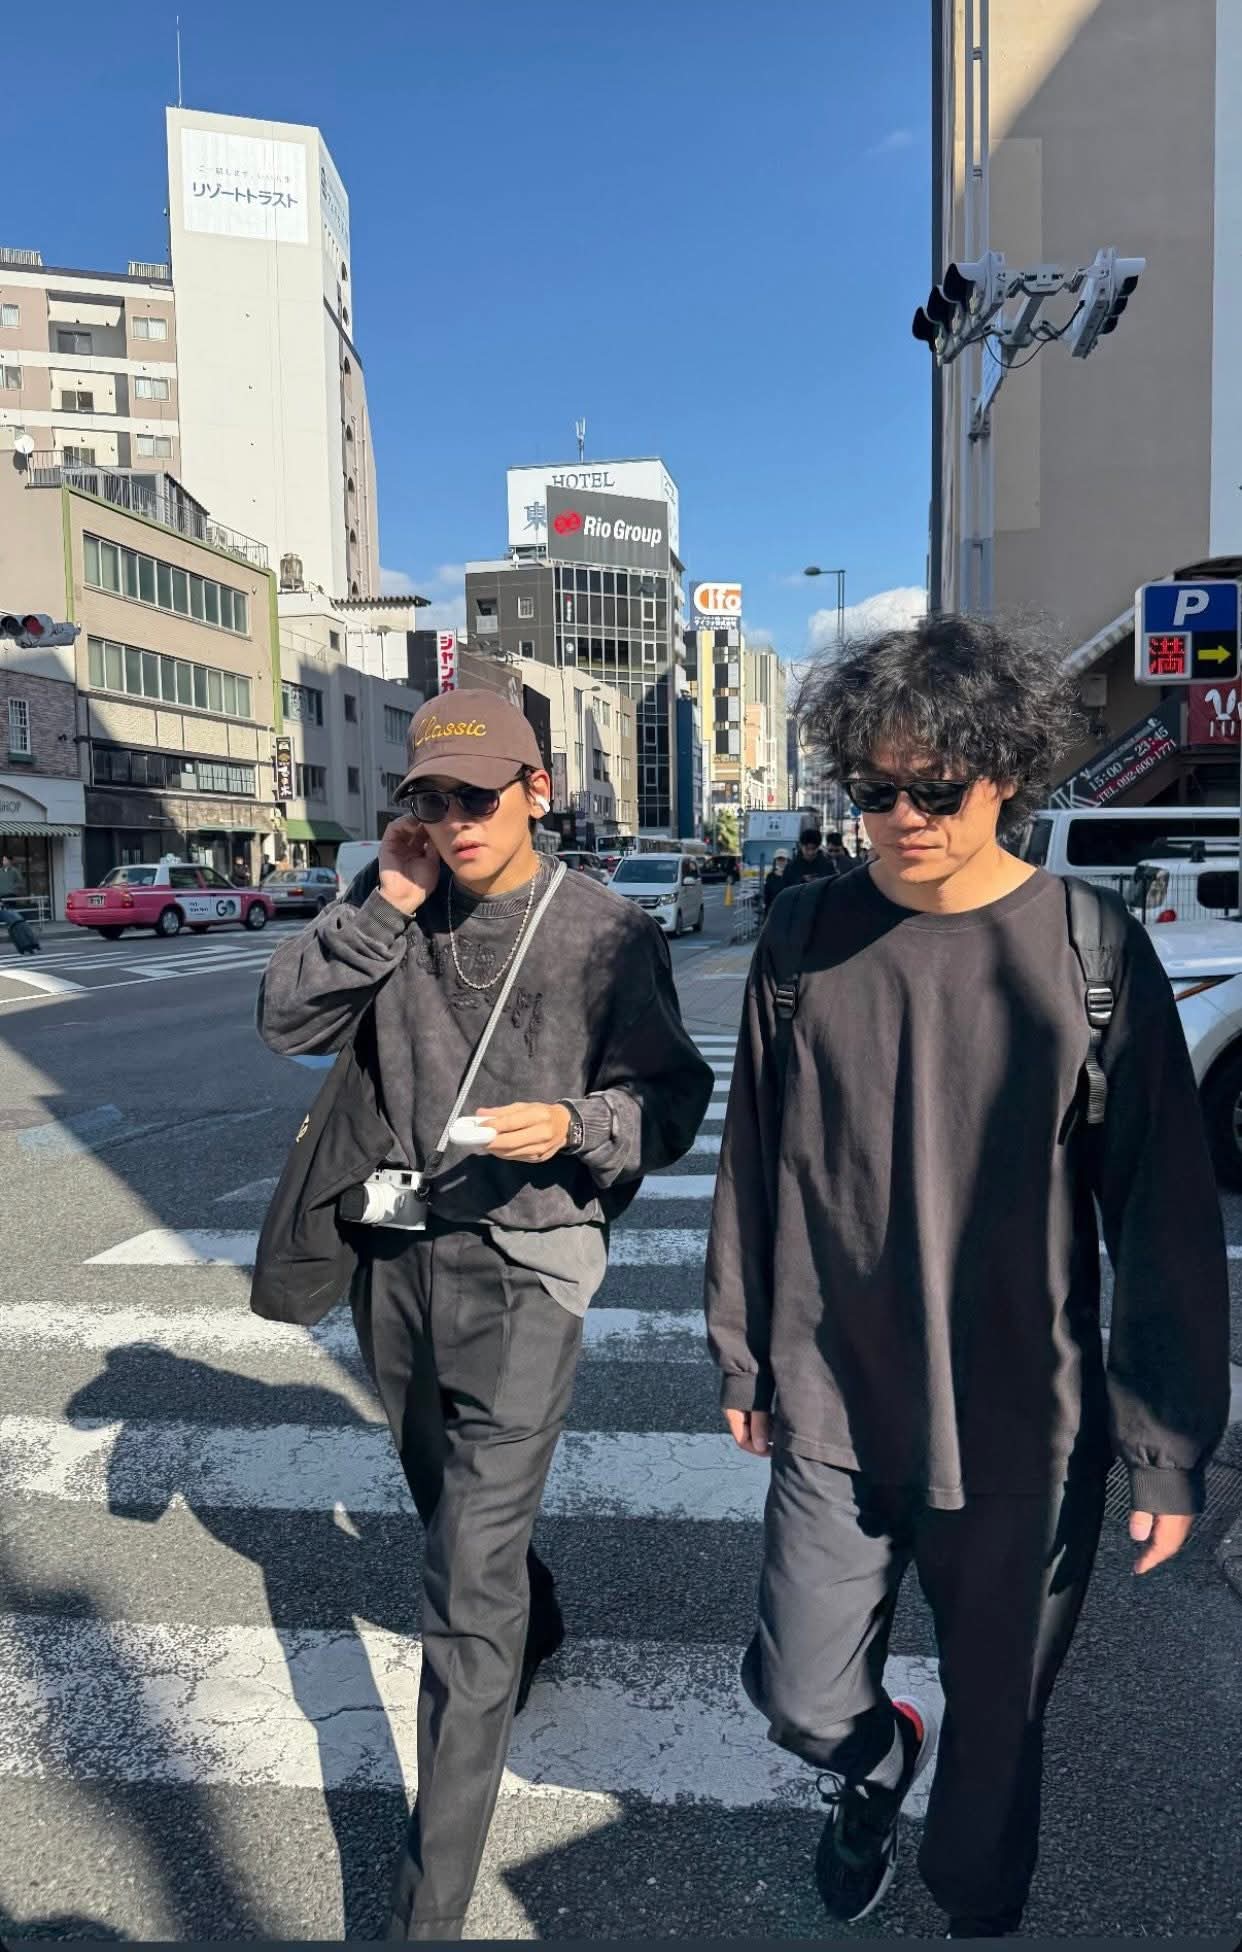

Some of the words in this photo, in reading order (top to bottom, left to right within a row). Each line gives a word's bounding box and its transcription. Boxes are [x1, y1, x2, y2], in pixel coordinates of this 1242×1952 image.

[192, 181, 299, 208] リゾートトラスト
[551, 471, 615, 488] HOTEL
[523, 501, 547, 531] 東
[584, 515, 612, 538] Rio
[613, 520, 662, 547] Group
[1173, 589, 1210, 626] P
[415, 716, 487, 746] Classic
[1088, 761, 1123, 792] 15:00
[216, 900, 236, 917] GO
